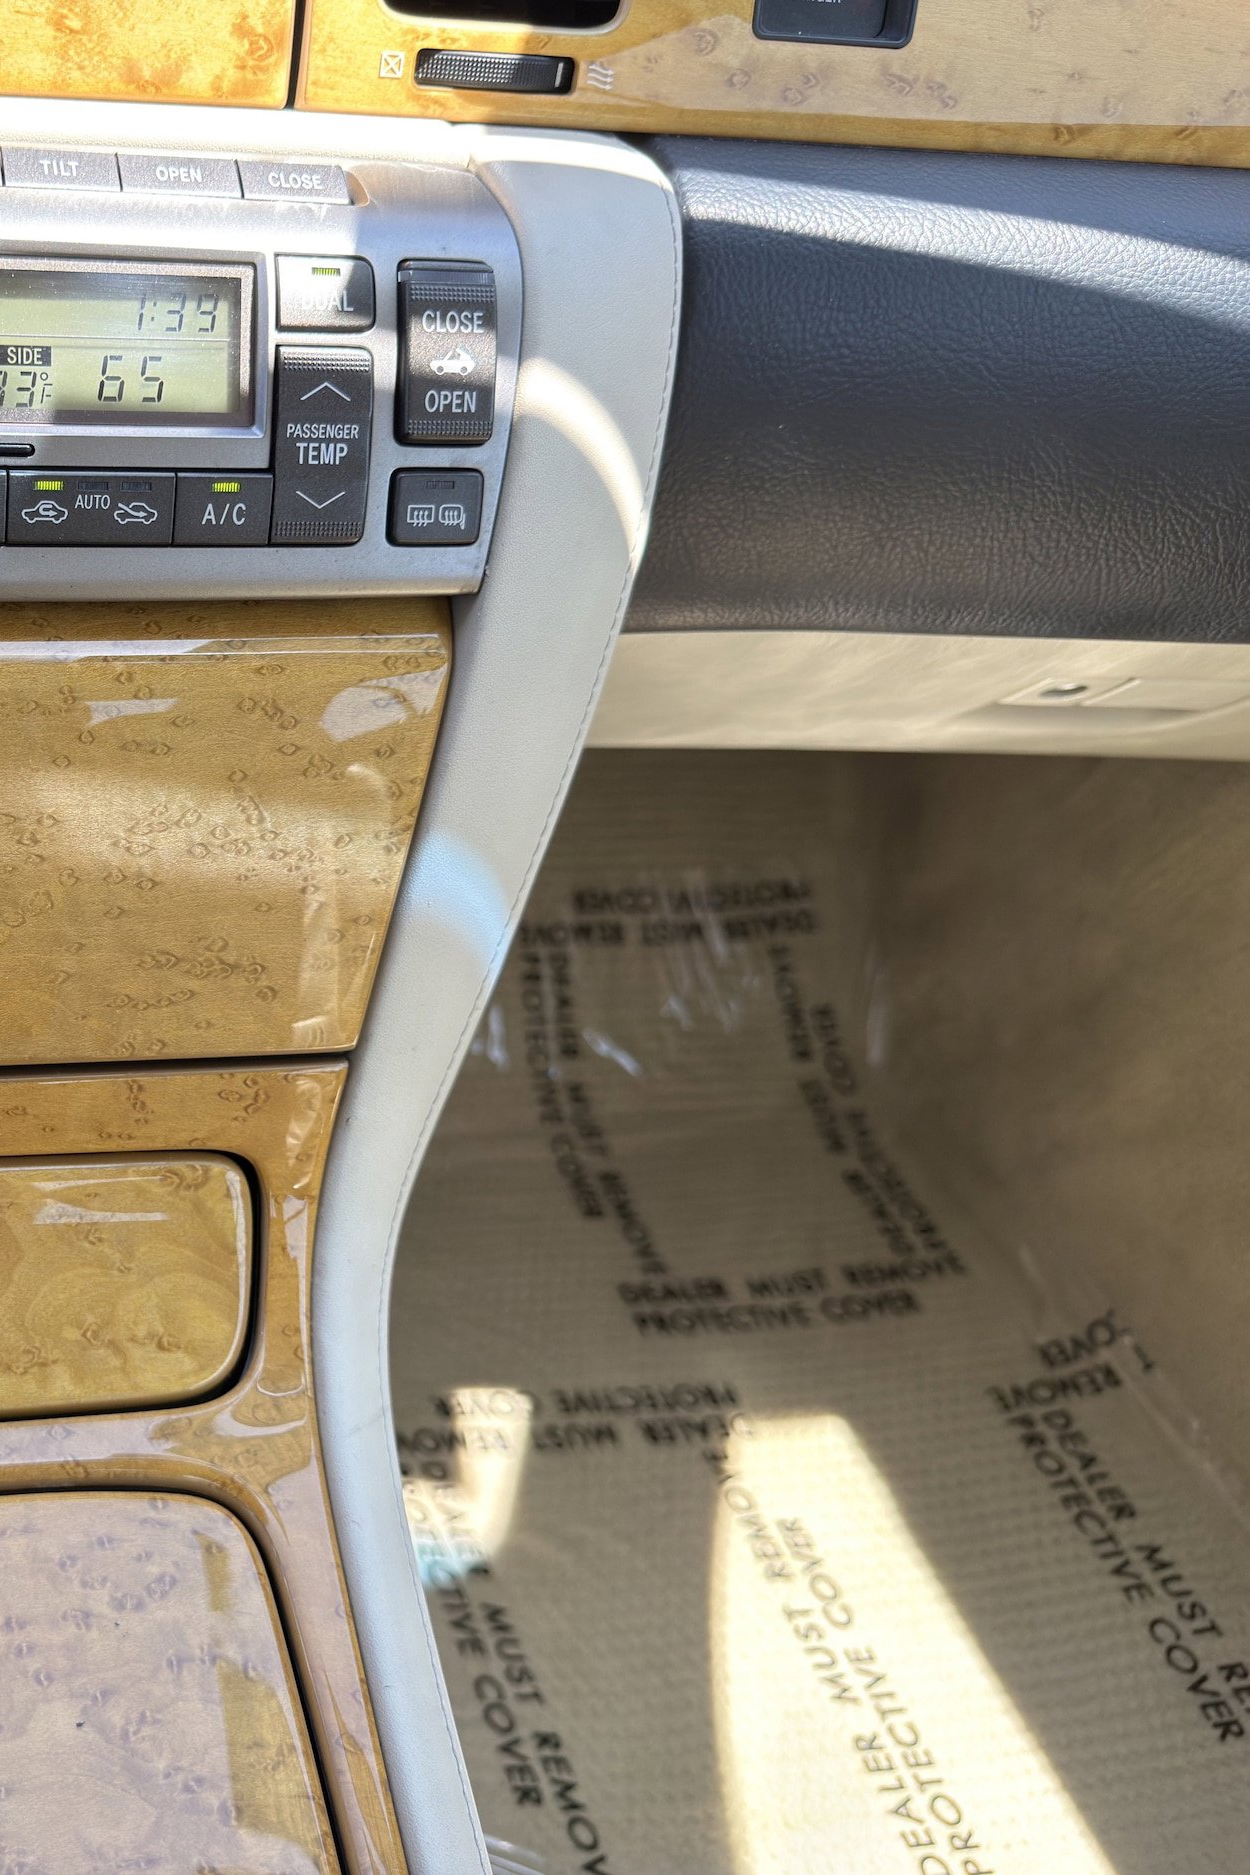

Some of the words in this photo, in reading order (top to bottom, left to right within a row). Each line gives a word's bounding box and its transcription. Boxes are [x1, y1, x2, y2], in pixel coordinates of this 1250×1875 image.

[39, 158, 79, 178] TILT
[155, 164, 203, 184] OPEN
[267, 171, 323, 191] CLOSE
[137, 292, 220, 335] 1:39
[301, 289, 355, 312] DUAL
[422, 310, 485, 334] CLOSE
[7, 347, 43, 366] SIDE
[97, 353, 165, 404] 65
[424, 390, 478, 414] OPEN
[286, 423, 360, 441] PASSENGER
[295, 442, 349, 467] TEMP
[74, 493, 111, 512] AUTO
[200, 502, 248, 527] A/C
[617, 1276, 729, 1306] DEALER
[745, 1266, 829, 1298] MUST
[840, 1249, 969, 1291] REMOVE
[630, 1301, 812, 1337] PROTECTIVE
[819, 1289, 921, 1324] COVER
[548, 1382, 740, 1418] PROTECTIVE
[984, 1362, 1123, 1413] REMOVE
[533, 1423, 621, 1454] MUST
[1040, 1407, 1138, 1525] DEALER
[1135, 1542, 1224, 1641] MUST
[777, 1516, 854, 1632] COVER
[1007, 1412, 1155, 1606] PROTECTIVE
[1148, 1616, 1245, 1744] COVER
[781, 1603, 862, 1706] MUST
[472, 1674, 543, 1809] COVER
[484, 1602, 544, 1708] MUST
[532, 1730, 613, 1875] REMOV
[843, 1644, 994, 1875] PROTECTIVE
[854, 1732, 952, 1875] DEALER
